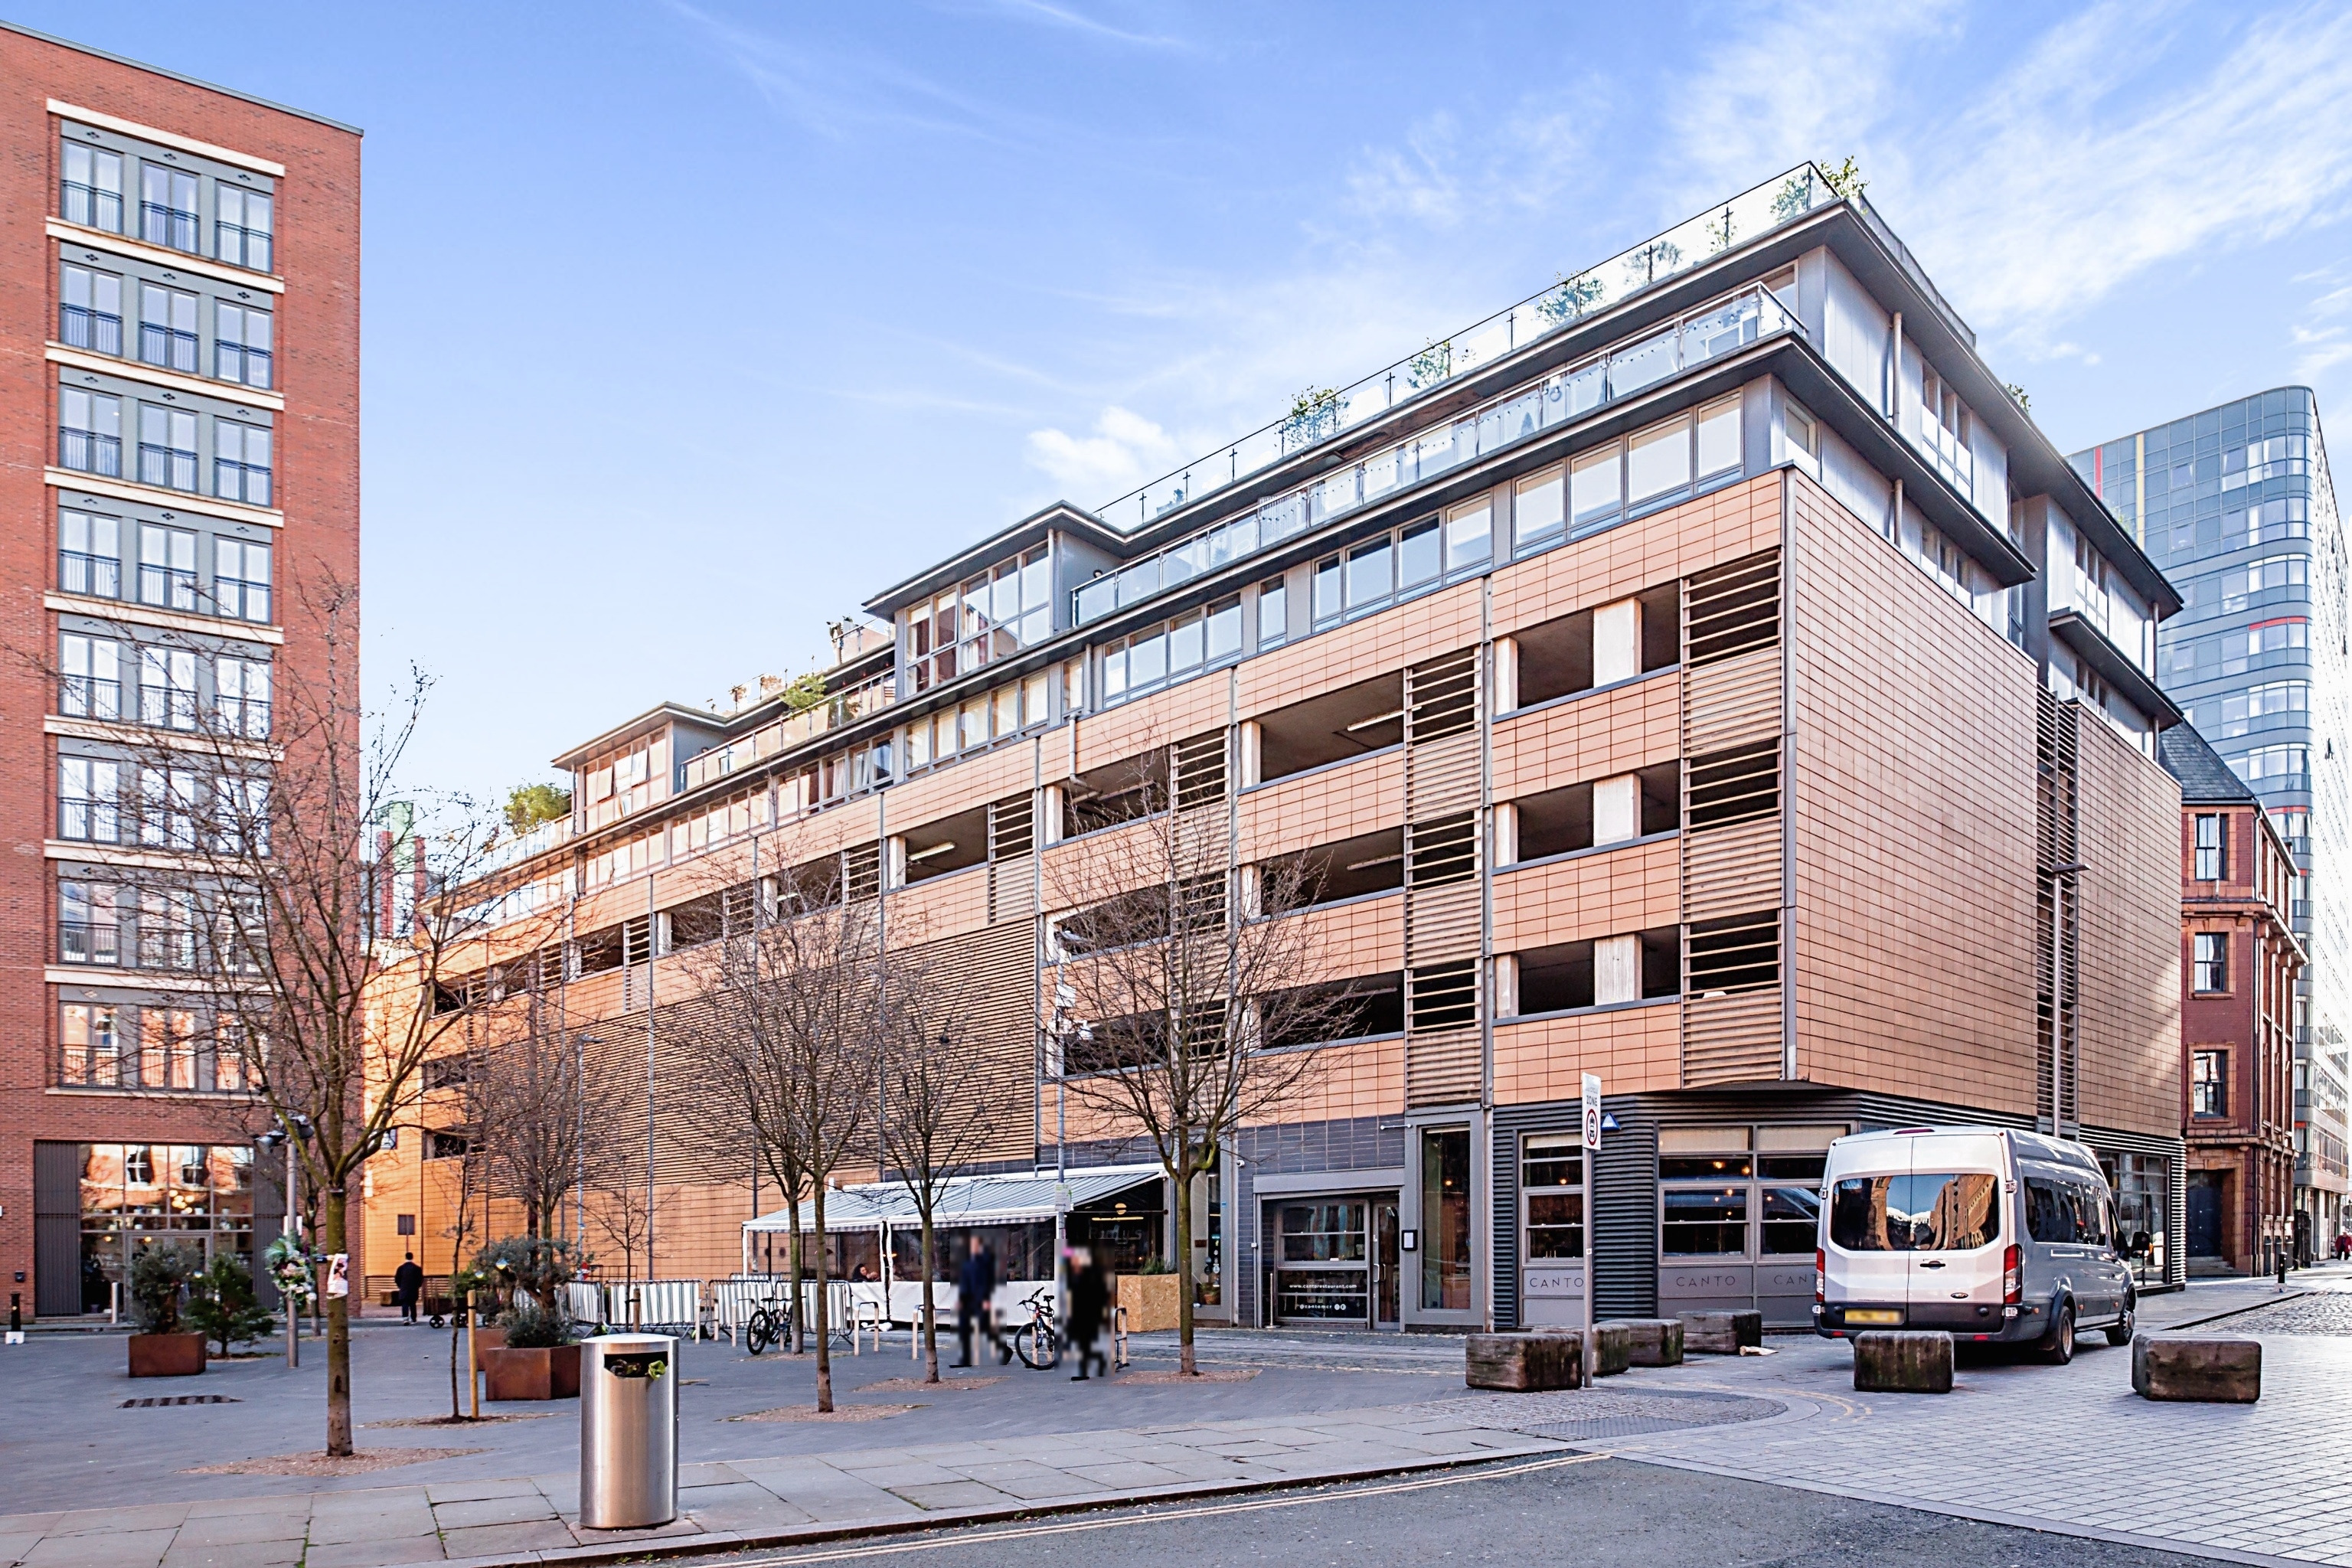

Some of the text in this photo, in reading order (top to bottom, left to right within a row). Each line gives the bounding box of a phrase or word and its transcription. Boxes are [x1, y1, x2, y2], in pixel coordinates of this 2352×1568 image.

[1586, 1096, 1598, 1106] ZONE
[1530, 1277, 1584, 1288] CANTO
[1676, 1276, 1736, 1287] CANTO
